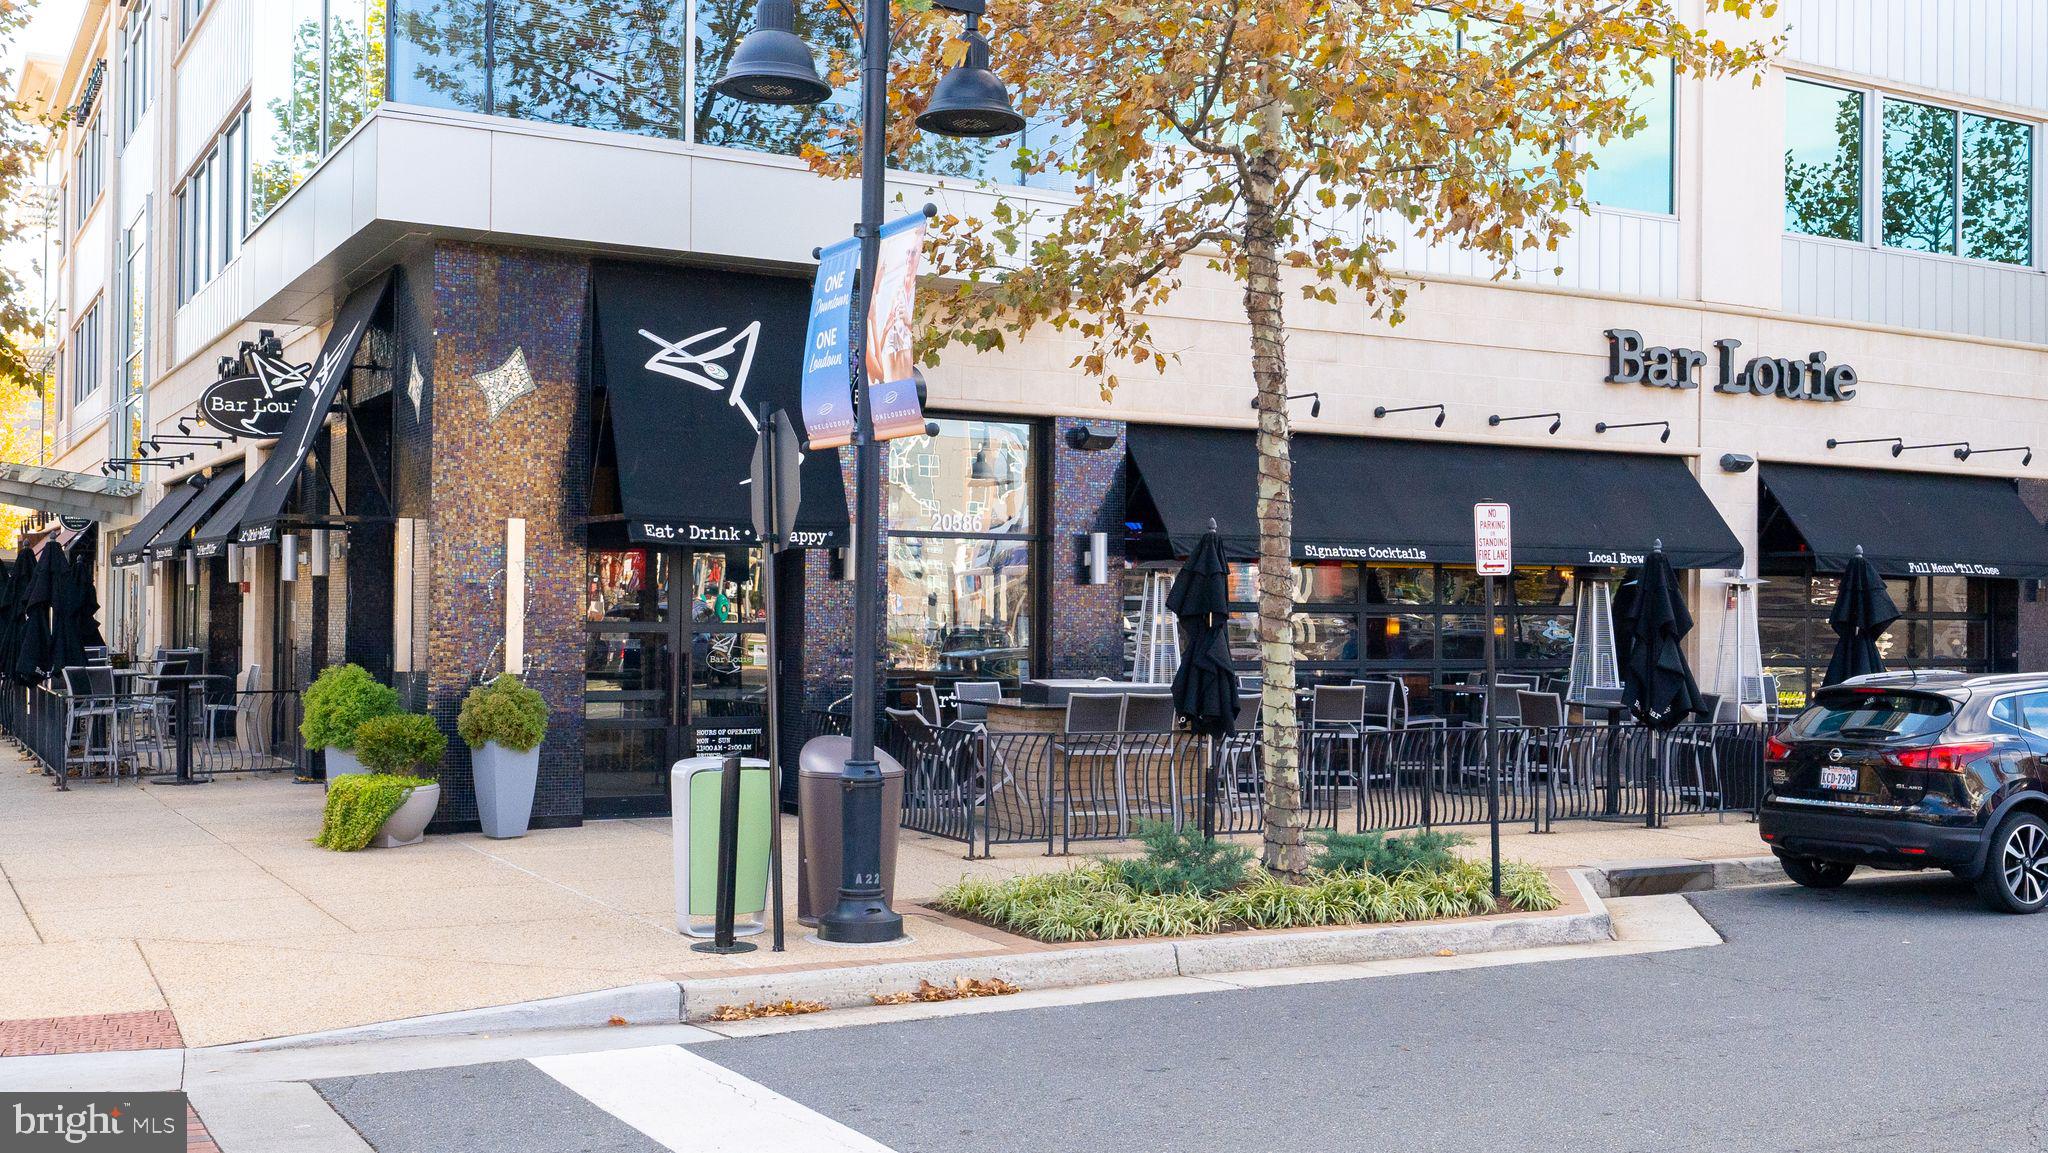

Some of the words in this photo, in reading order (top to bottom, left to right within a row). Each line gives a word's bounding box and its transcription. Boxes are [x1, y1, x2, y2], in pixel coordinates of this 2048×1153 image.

[824, 271, 846, 293] ONE
[814, 293, 849, 318] Downtown
[816, 328, 837, 350] ONE
[808, 348, 843, 374] Loudoun
[1603, 328, 1707, 389] Bar
[1713, 338, 1858, 402] Louie
[211, 396, 248, 412] Bar
[253, 398, 299, 414] Loui
[1487, 509, 1497, 518] NO
[930, 514, 983, 531] 20586
[1479, 520, 1506, 530] PARKING
[643, 524, 675, 539] Eat
[689, 525, 740, 541] Drink
[789, 531, 828, 545] appy
[1478, 538, 1508, 547] STANDING
[1304, 545, 1367, 559] Signature
[1368, 546, 1427, 560] Cocktails
[1478, 550, 1491, 560] FIRE
[1492, 550, 1508, 560] LANE
[1588, 551, 1618, 564] Local
[1908, 562, 1931, 573] Full
[1930, 563, 1956, 573] Menu
[1974, 564, 2000, 575] Close
[709, 655, 725, 663] Bar
[727, 655, 753, 663] Louie
